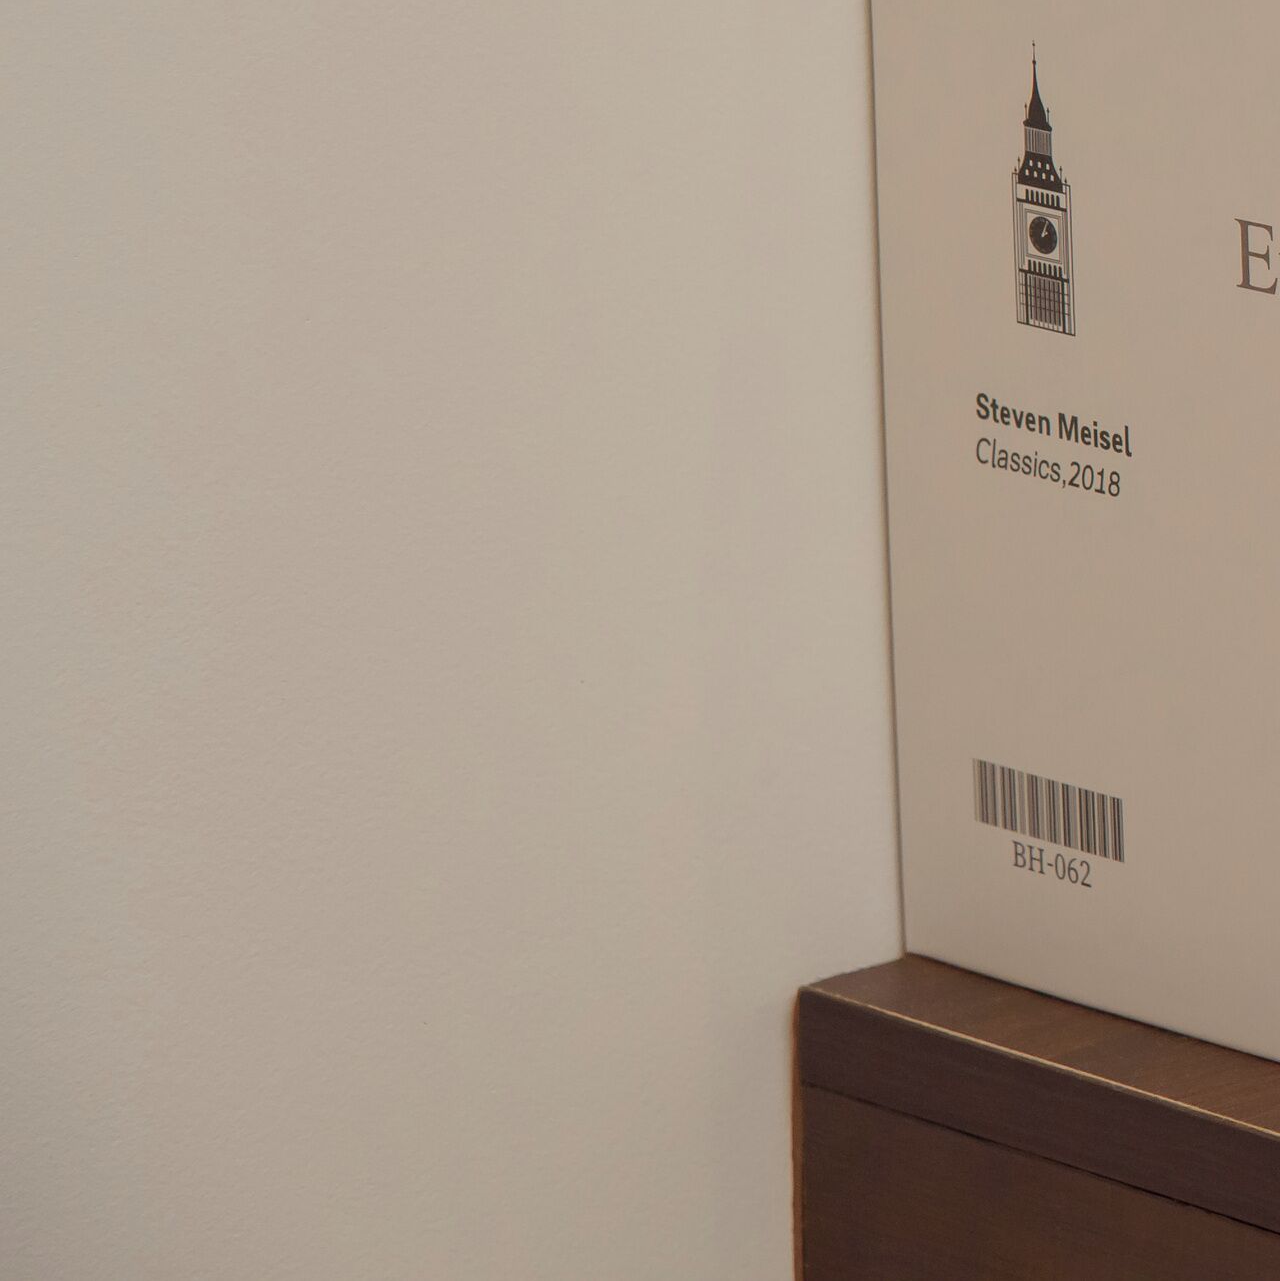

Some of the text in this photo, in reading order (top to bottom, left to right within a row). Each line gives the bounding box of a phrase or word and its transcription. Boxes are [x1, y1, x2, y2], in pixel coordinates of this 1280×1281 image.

[975, 393, 1132, 458] Steven Meisel
[975, 437, 1121, 498] Classics,2018
[1012, 839, 1092, 888] BH-062
